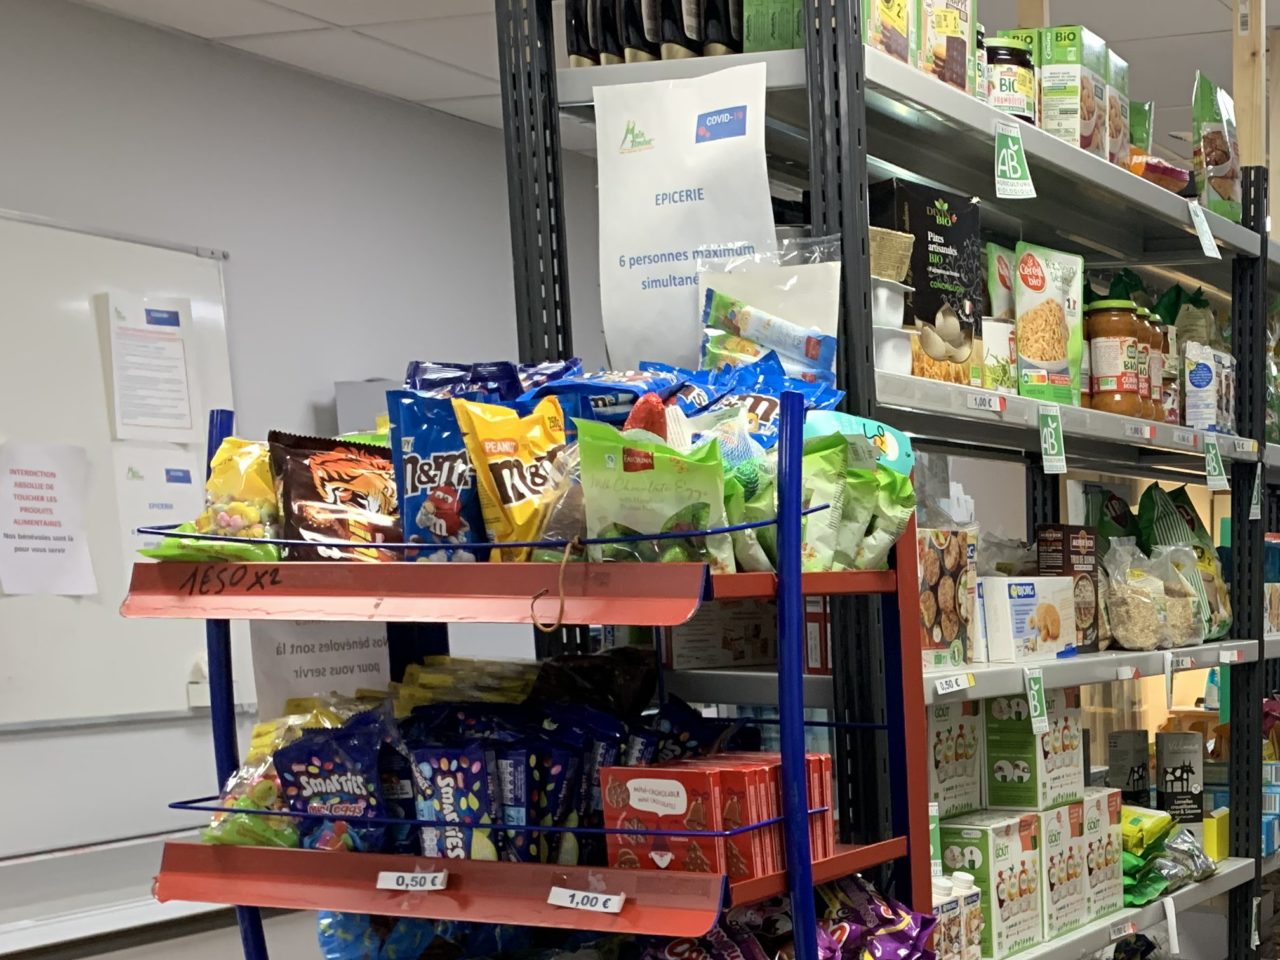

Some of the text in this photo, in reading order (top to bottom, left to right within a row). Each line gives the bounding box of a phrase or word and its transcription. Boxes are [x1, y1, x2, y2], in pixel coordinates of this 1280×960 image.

[998, 148, 1021, 178] AB
[655, 188, 705, 206] EPICERIE
[936, 216, 952, 227] BIO
[619, 244, 755, 269] 6 personnes maximum
[9, 468, 57, 478] INTERDICTION
[13, 494, 45, 502] TOUCHER
[20, 506, 53, 515] PRODUITS
[13, 518, 62, 528] ALIMENTAIRES
[3, 532, 16, 540] Nos
[14, 546, 29, 554] pour
[395, 874, 438, 889] 0,50 €
[568, 892, 611, 909] 1,00 €
